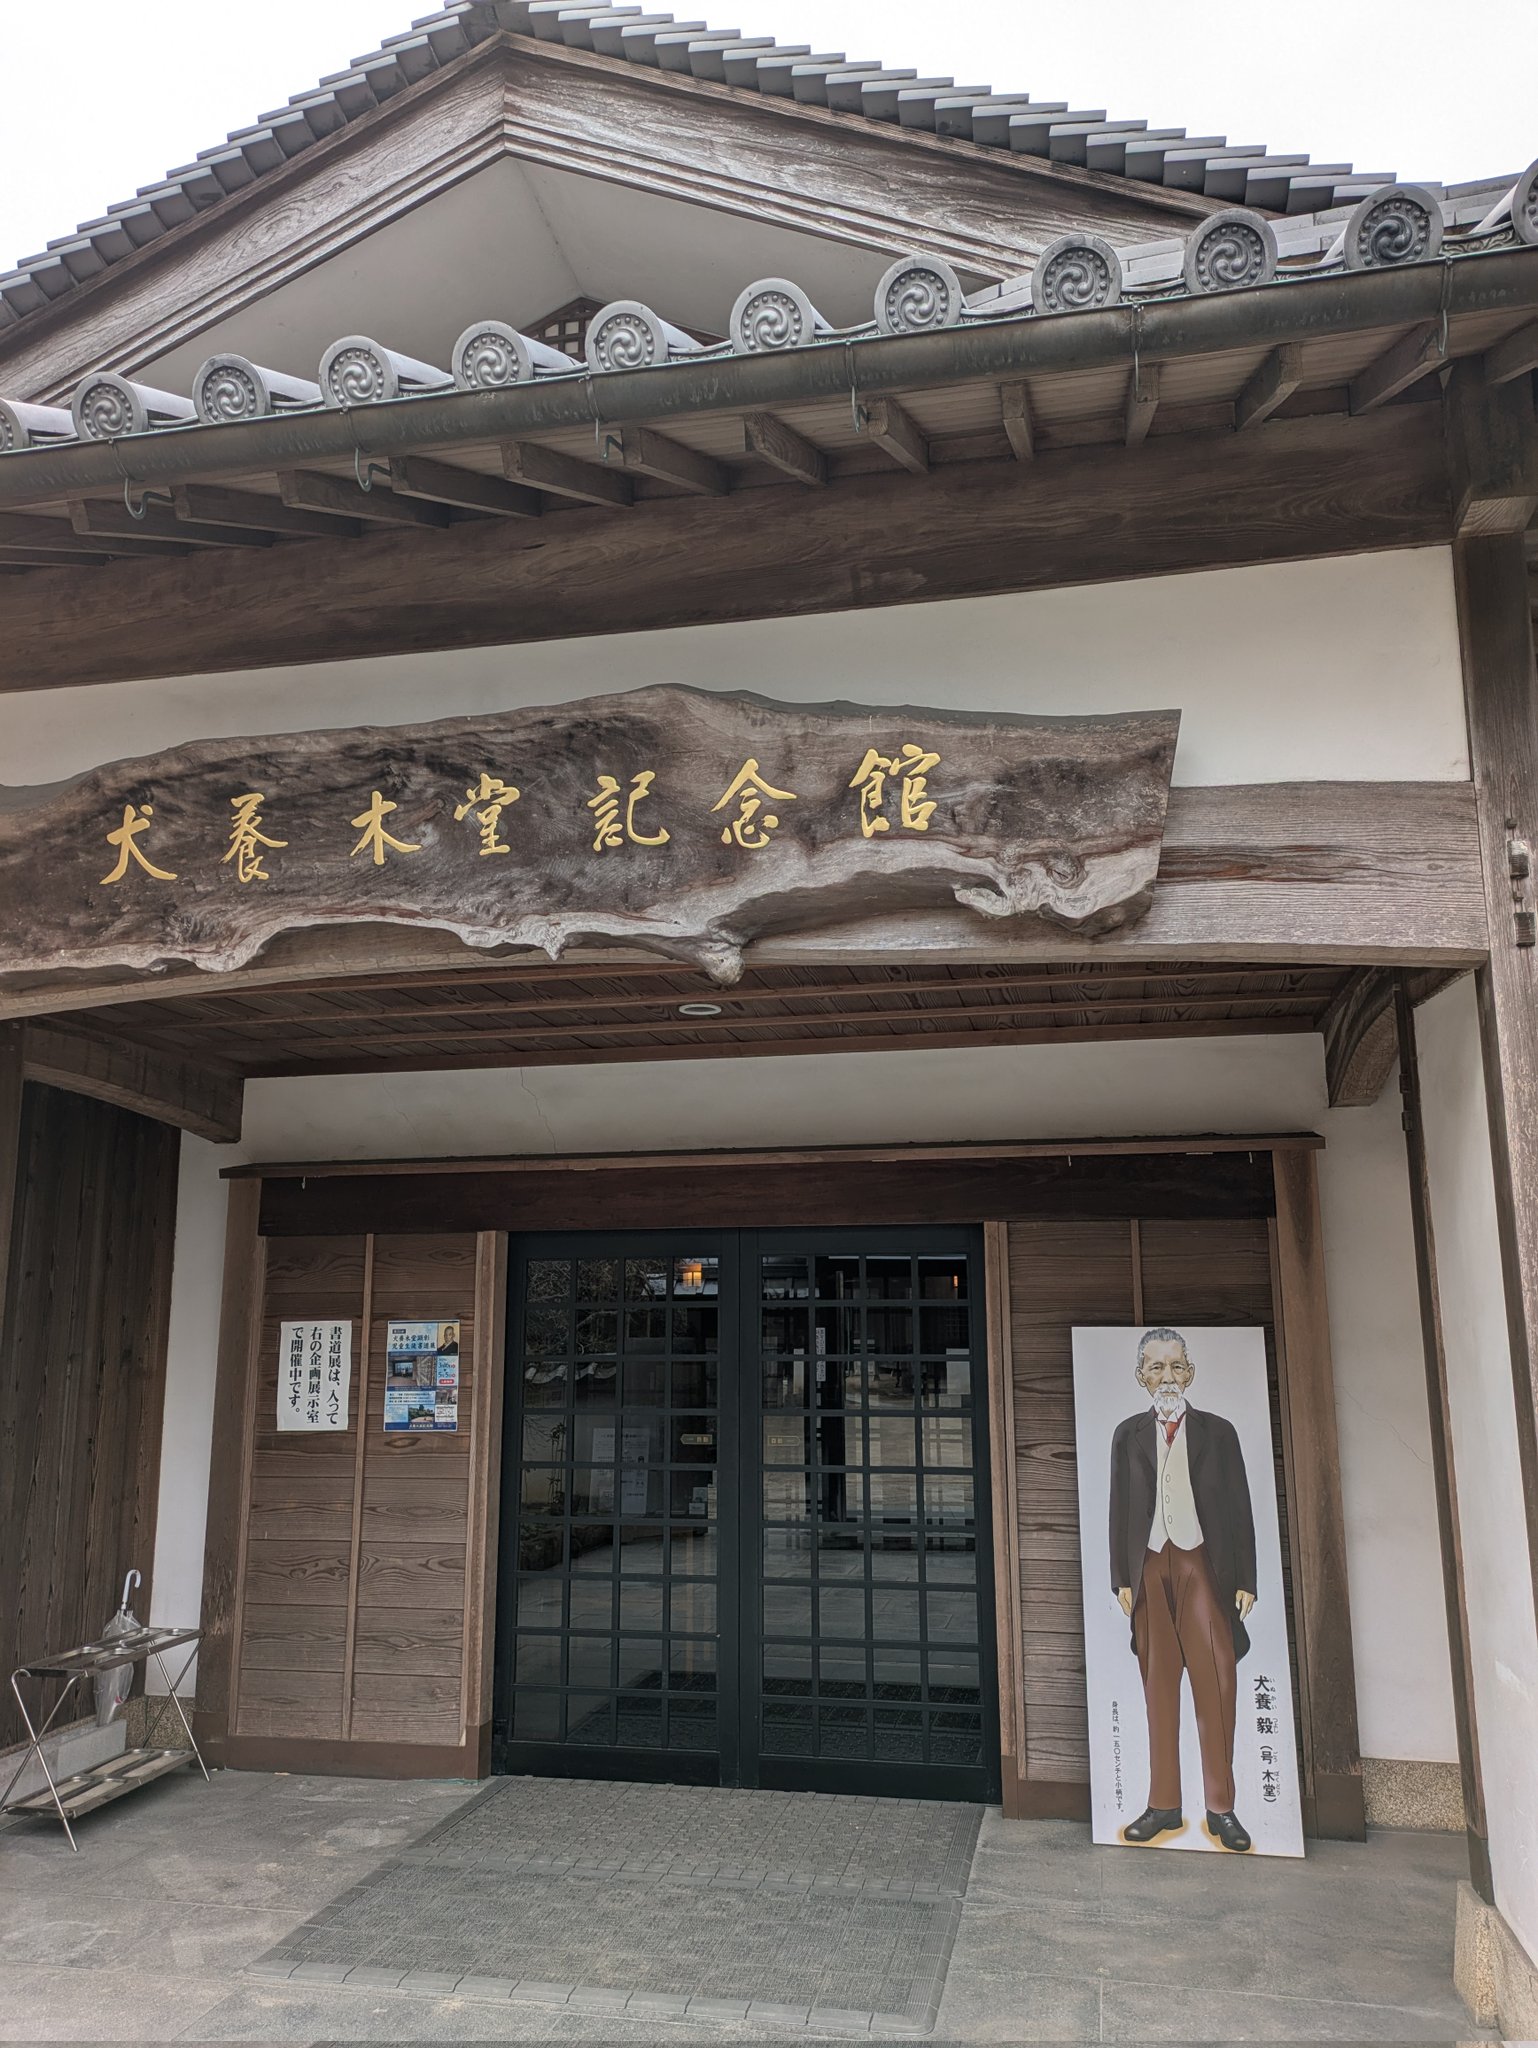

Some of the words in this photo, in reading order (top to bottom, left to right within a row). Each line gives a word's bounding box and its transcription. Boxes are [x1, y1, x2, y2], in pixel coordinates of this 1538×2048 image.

[289, 1327, 303, 1413] で開催中です。
[307, 1327, 322, 1424] 右の企画展示室
[326, 1326, 343, 1425] 書道展は、入って
[1254, 1675, 1271, 1710] 犬養
